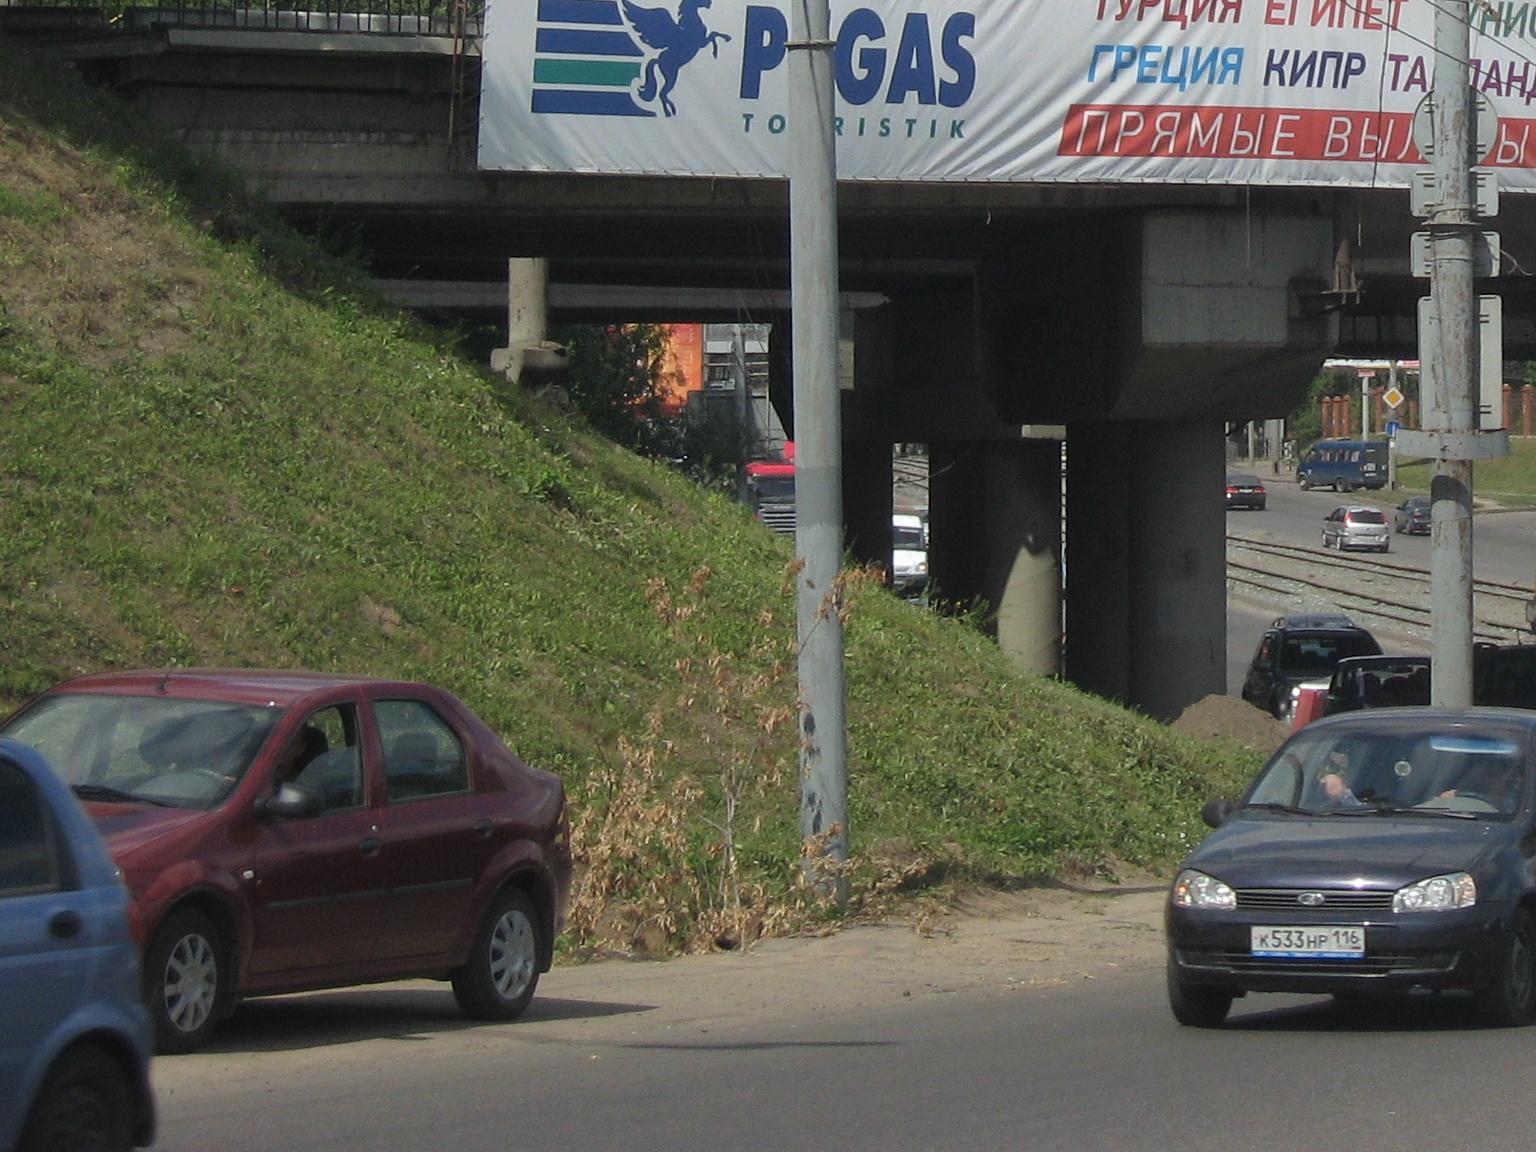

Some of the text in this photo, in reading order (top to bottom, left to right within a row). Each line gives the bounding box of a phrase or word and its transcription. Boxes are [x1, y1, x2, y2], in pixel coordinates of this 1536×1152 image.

[740, 5, 976, 108] PGAS
[1087, 44, 1244, 91] ГРЕЦИЯ
[1263, 48, 1366, 89] КИПР
[742, 113, 965, 139] TORISTIK
[1075, 110, 1303, 157] ПРЯМЫЕ
[1323, 115, 1530, 165] ВЫЛЫ
